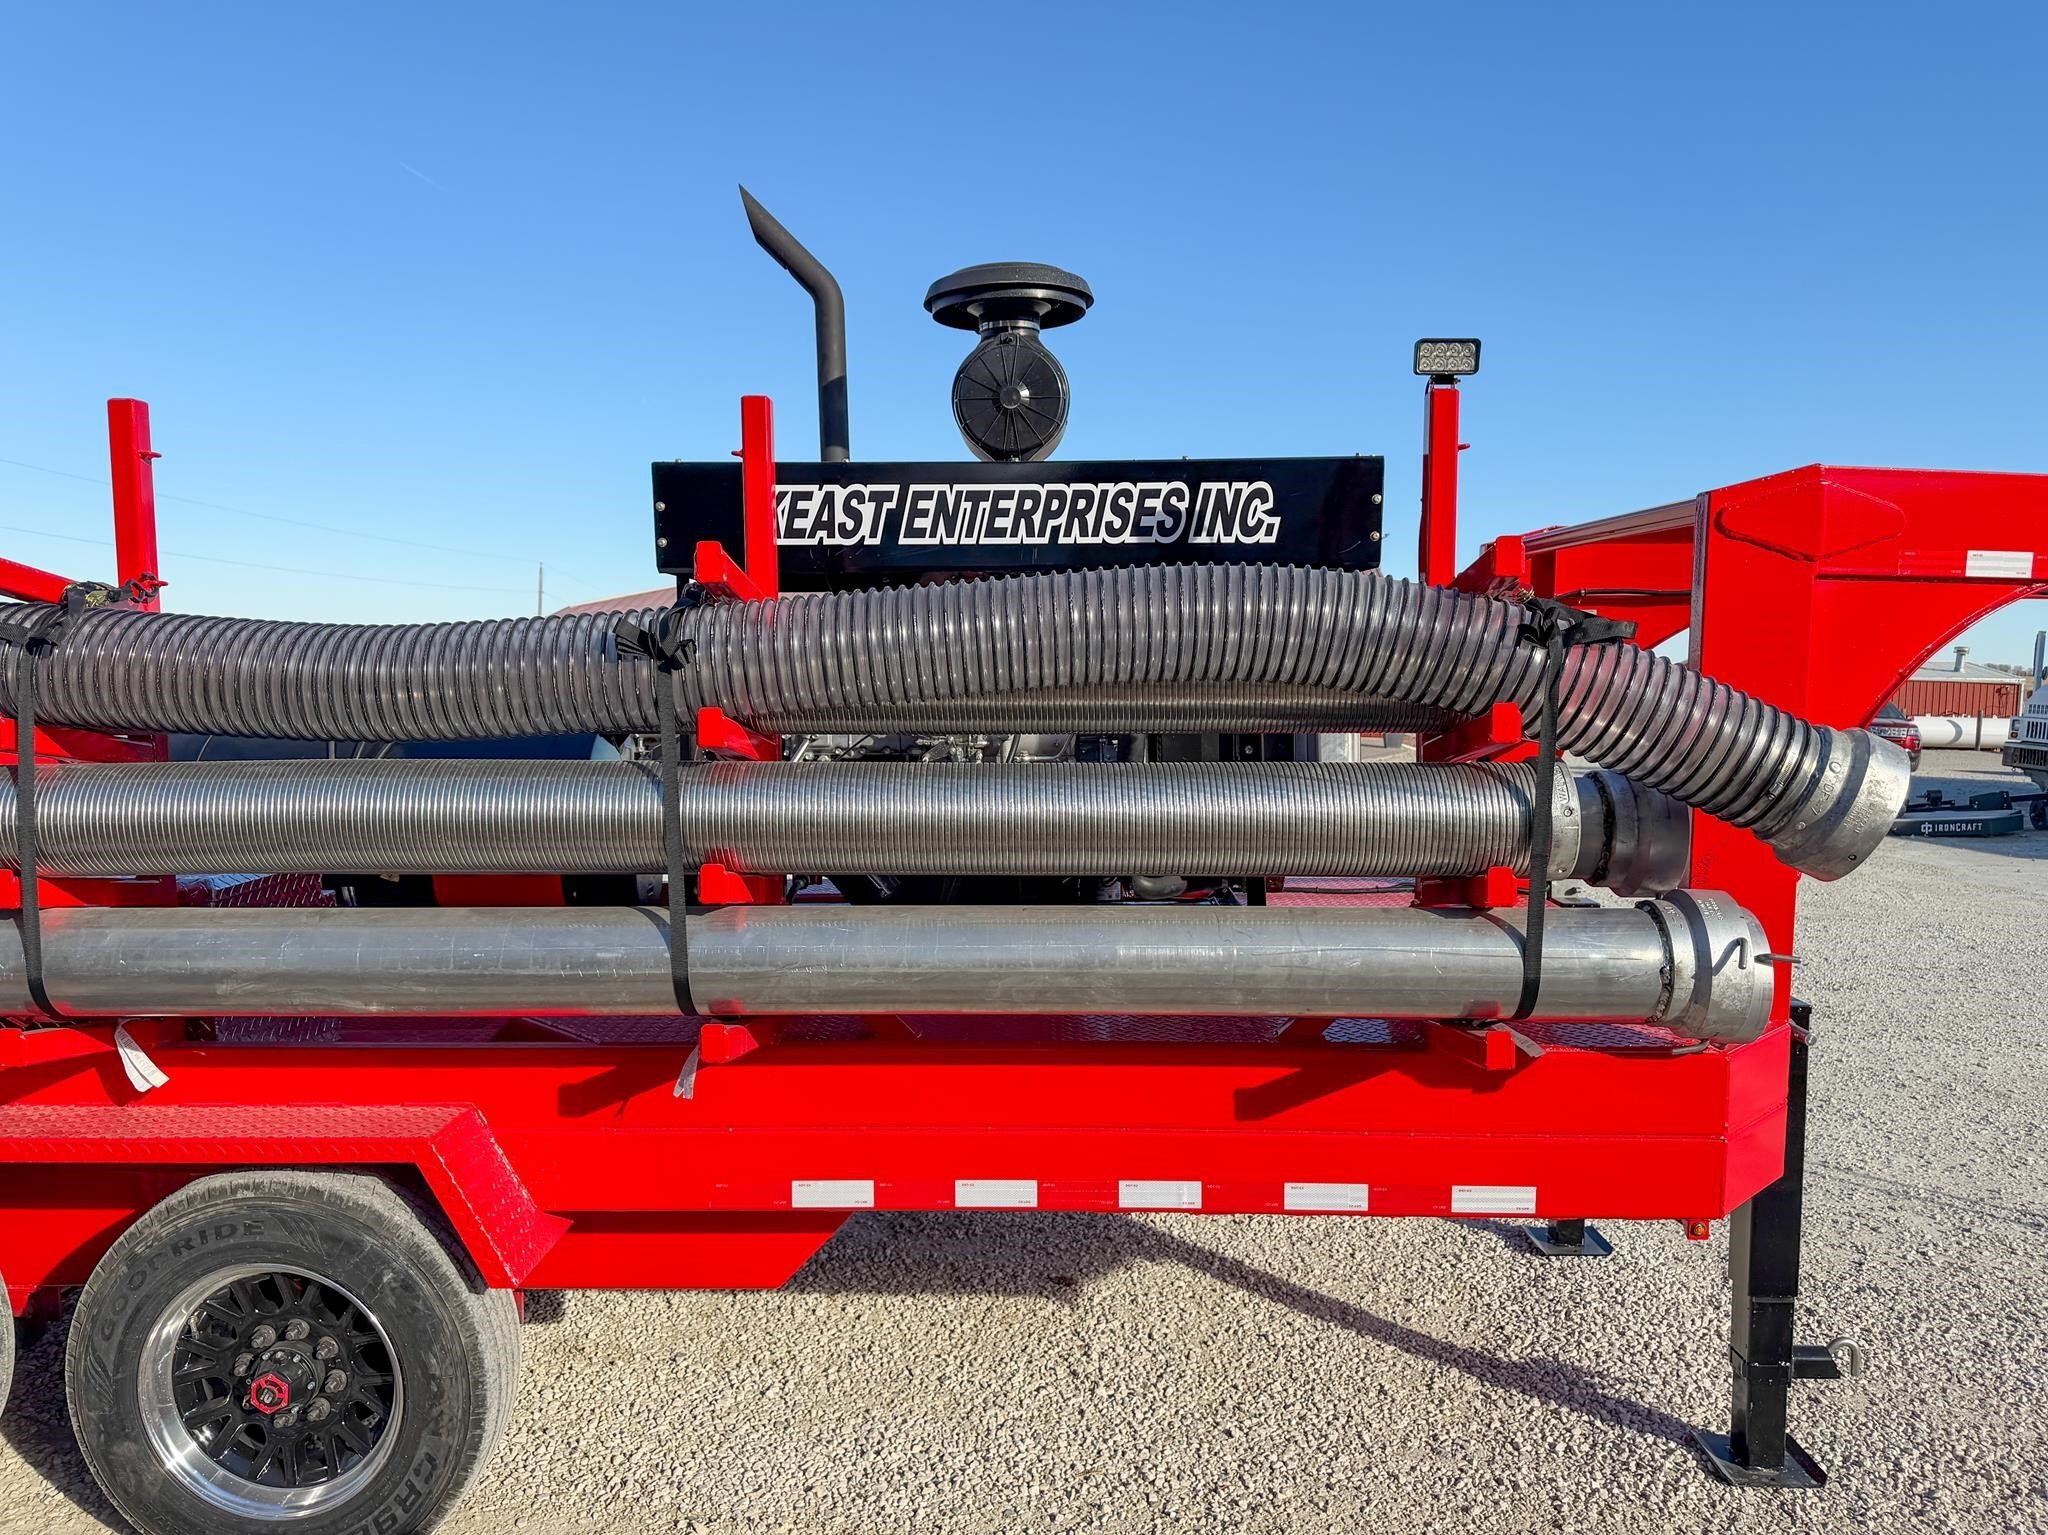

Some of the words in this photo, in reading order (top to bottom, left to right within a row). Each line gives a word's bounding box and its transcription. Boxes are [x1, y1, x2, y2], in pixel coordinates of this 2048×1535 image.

[898, 481, 1189, 545] ENTERPRISES
[1188, 481, 1281, 544] INC.
[1934, 822, 1983, 832] IRONCRAFT
